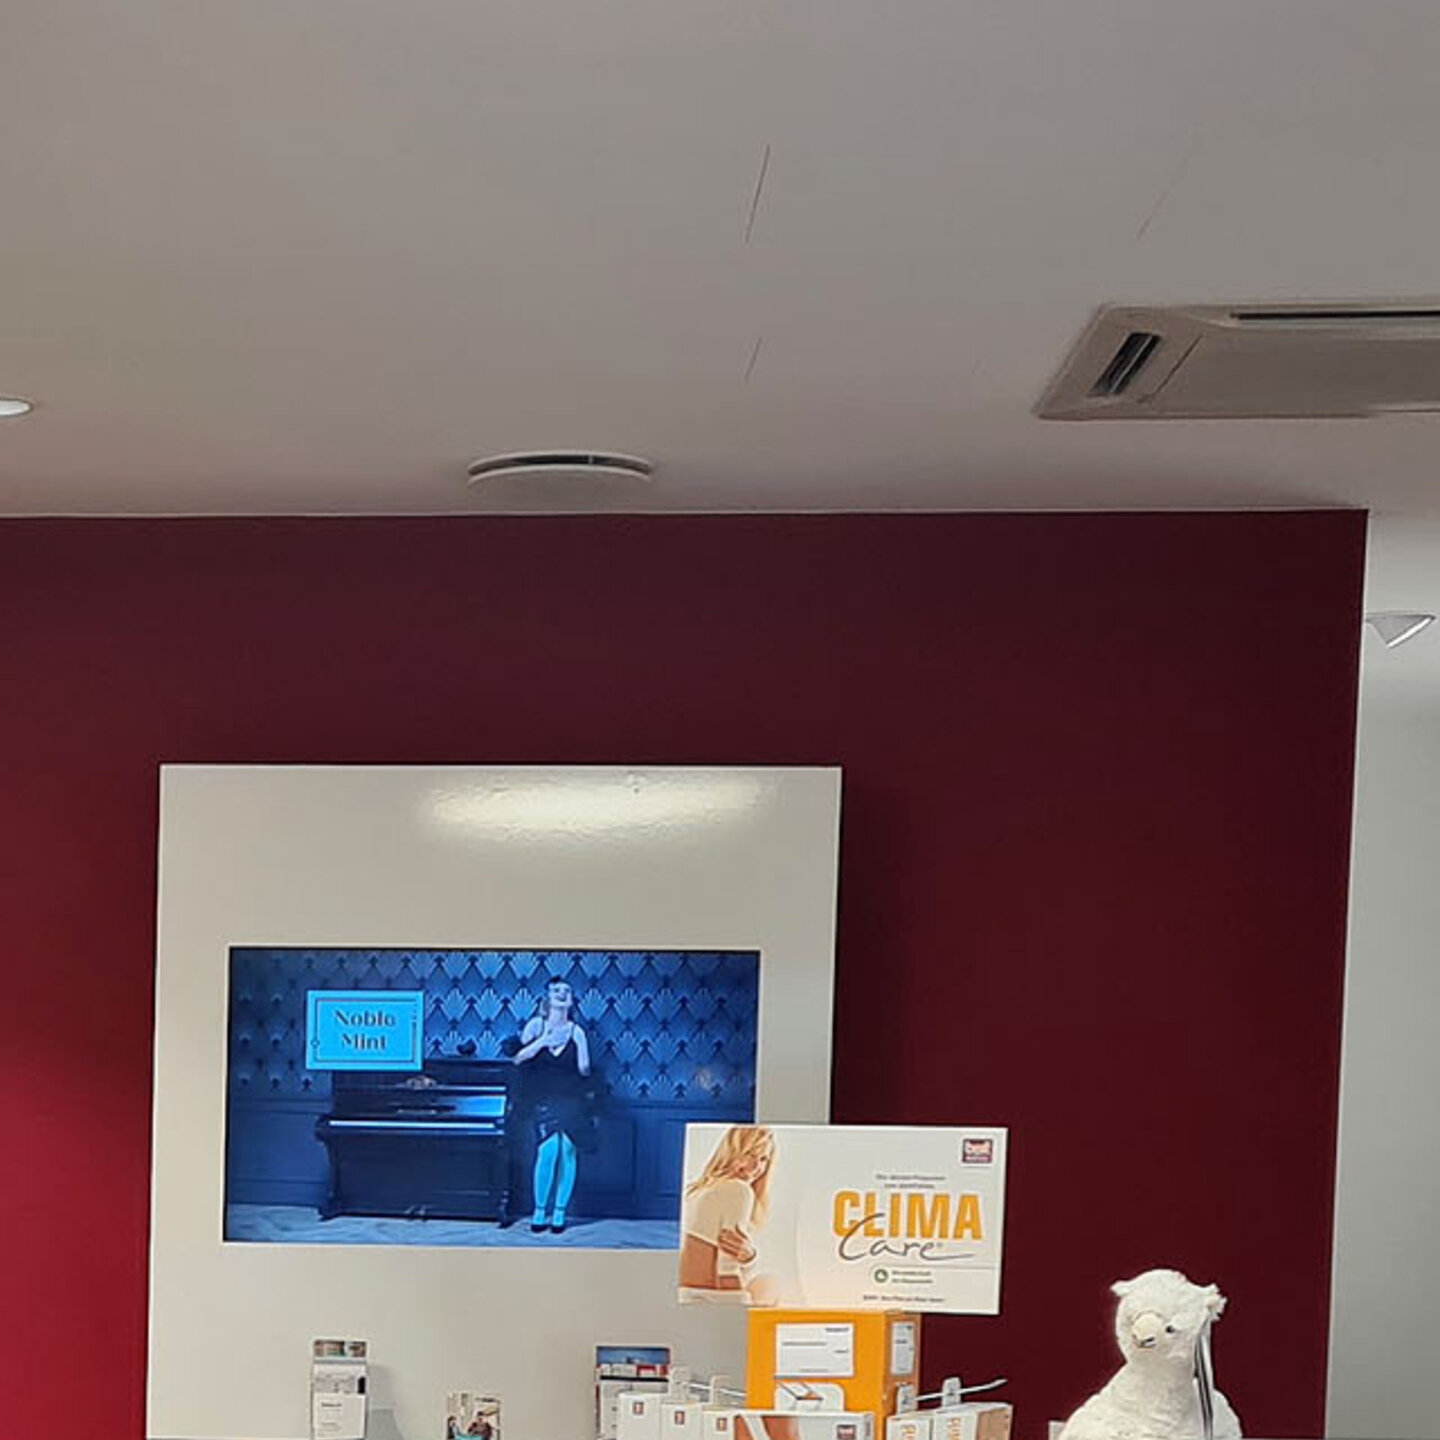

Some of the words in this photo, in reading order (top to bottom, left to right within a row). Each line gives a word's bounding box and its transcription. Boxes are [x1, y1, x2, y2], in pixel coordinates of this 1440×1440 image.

[335, 1010, 396, 1027] Noble
[342, 1033, 386, 1050] Mint
[833, 1190, 983, 1240] CLIMA
